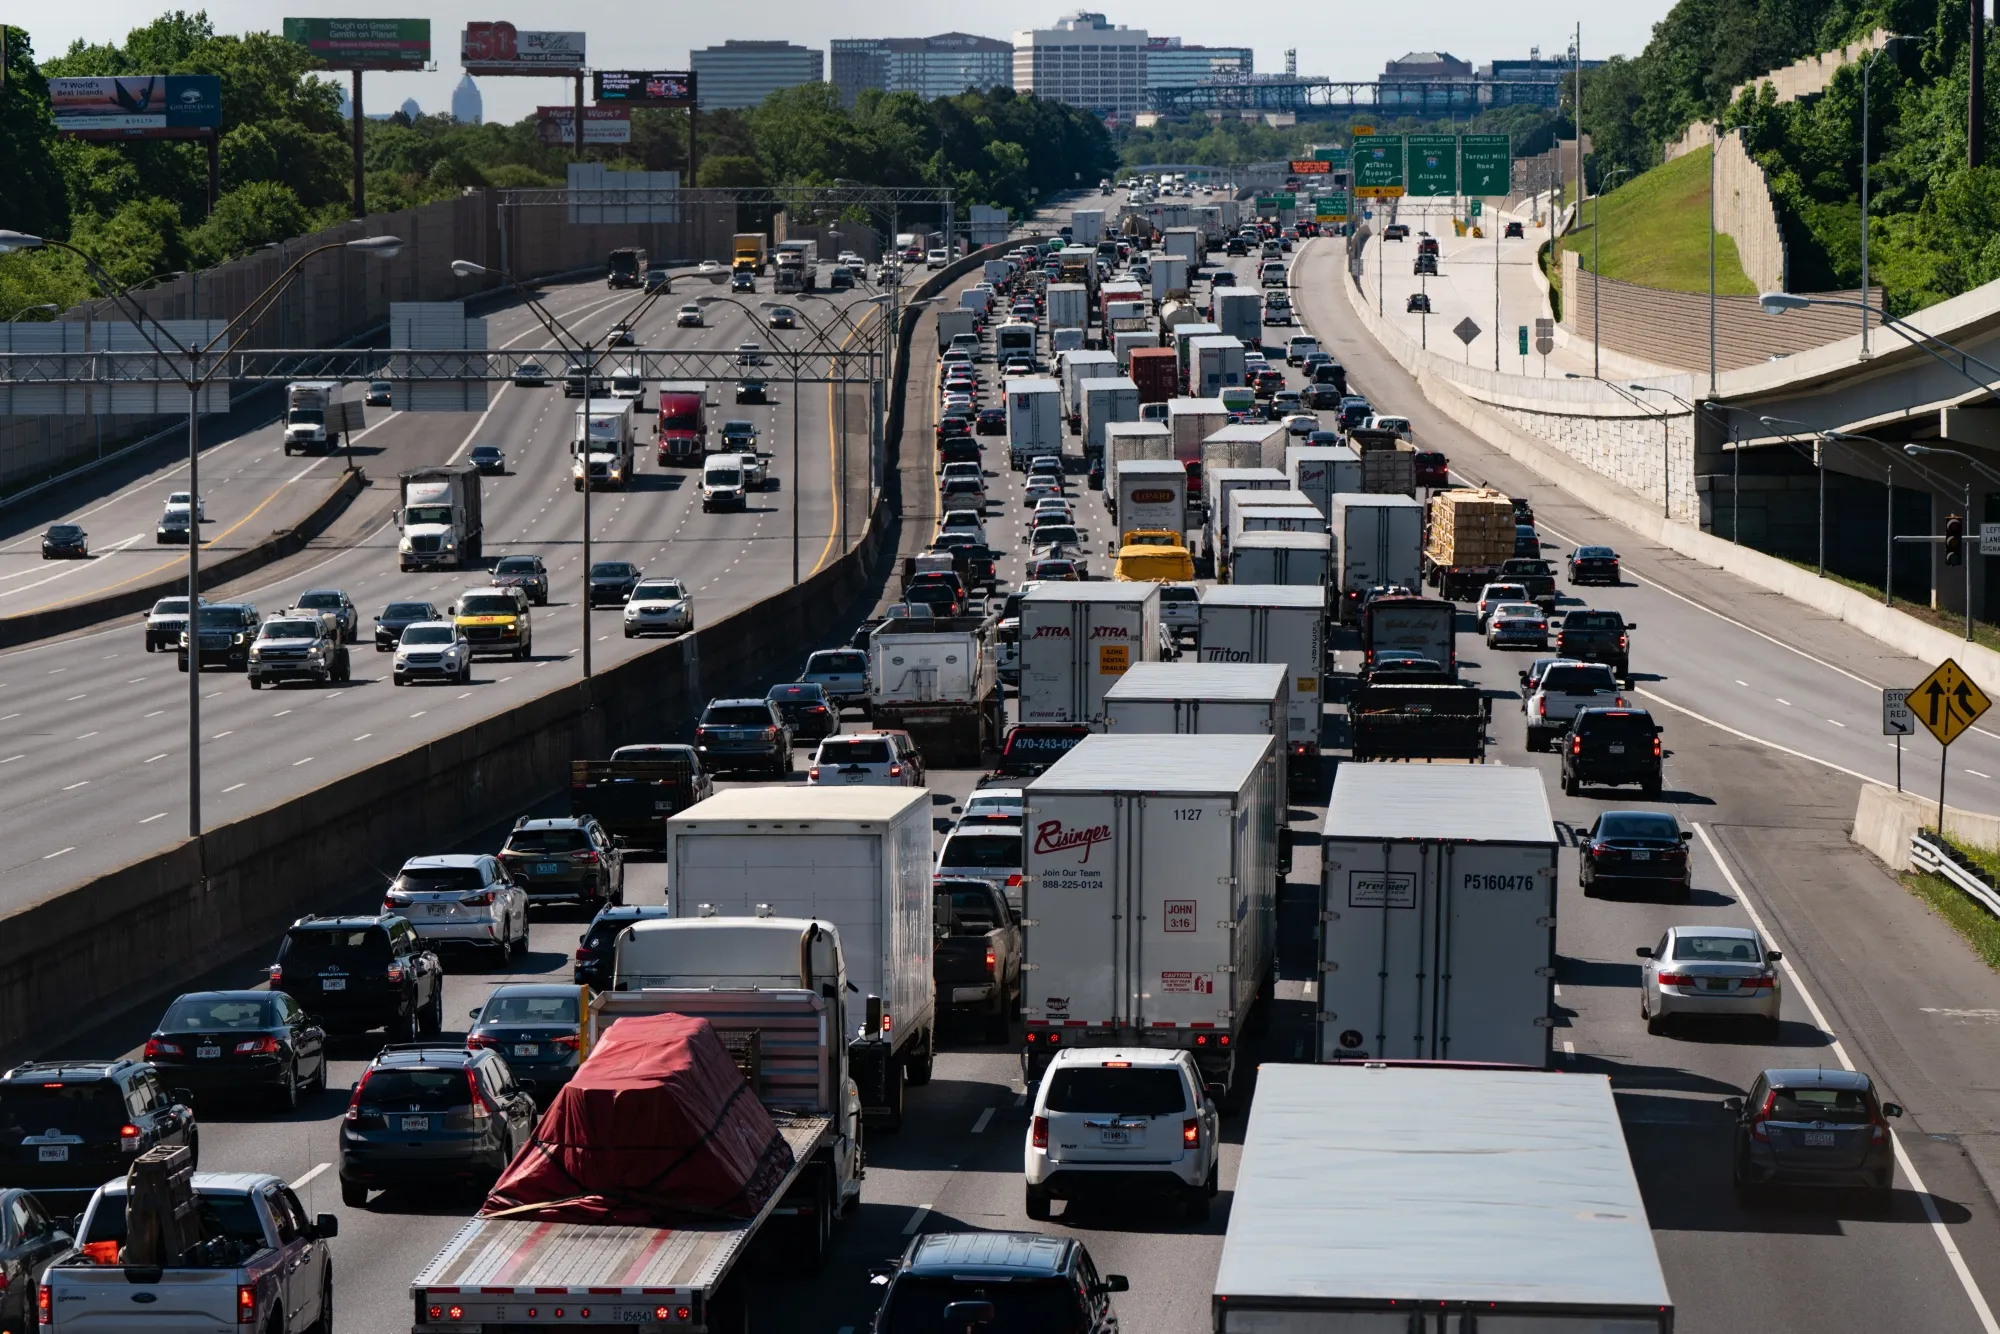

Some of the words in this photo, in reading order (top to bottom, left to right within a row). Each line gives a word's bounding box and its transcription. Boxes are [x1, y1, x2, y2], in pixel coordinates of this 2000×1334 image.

[330, 22, 356, 30] Tough
[330, 30, 356, 38] Gentle
[549, 110, 572, 118] Hurt
[588, 110, 620, 118] Work?
[1032, 626, 1070, 640] XTRA
[1089, 626, 1128, 640] XTRA
[1203, 647, 1250, 662] Triton
[1890, 710, 1907, 718] RED
[1016, 738, 1080, 749] 470-243-02
[1173, 809, 1202, 820] 1127
[1034, 820, 1112, 864] Risinger
[1464, 874, 1534, 892] P5160476
[1168, 904, 1192, 914] JOHN
[1170, 918, 1190, 928] 3:16
